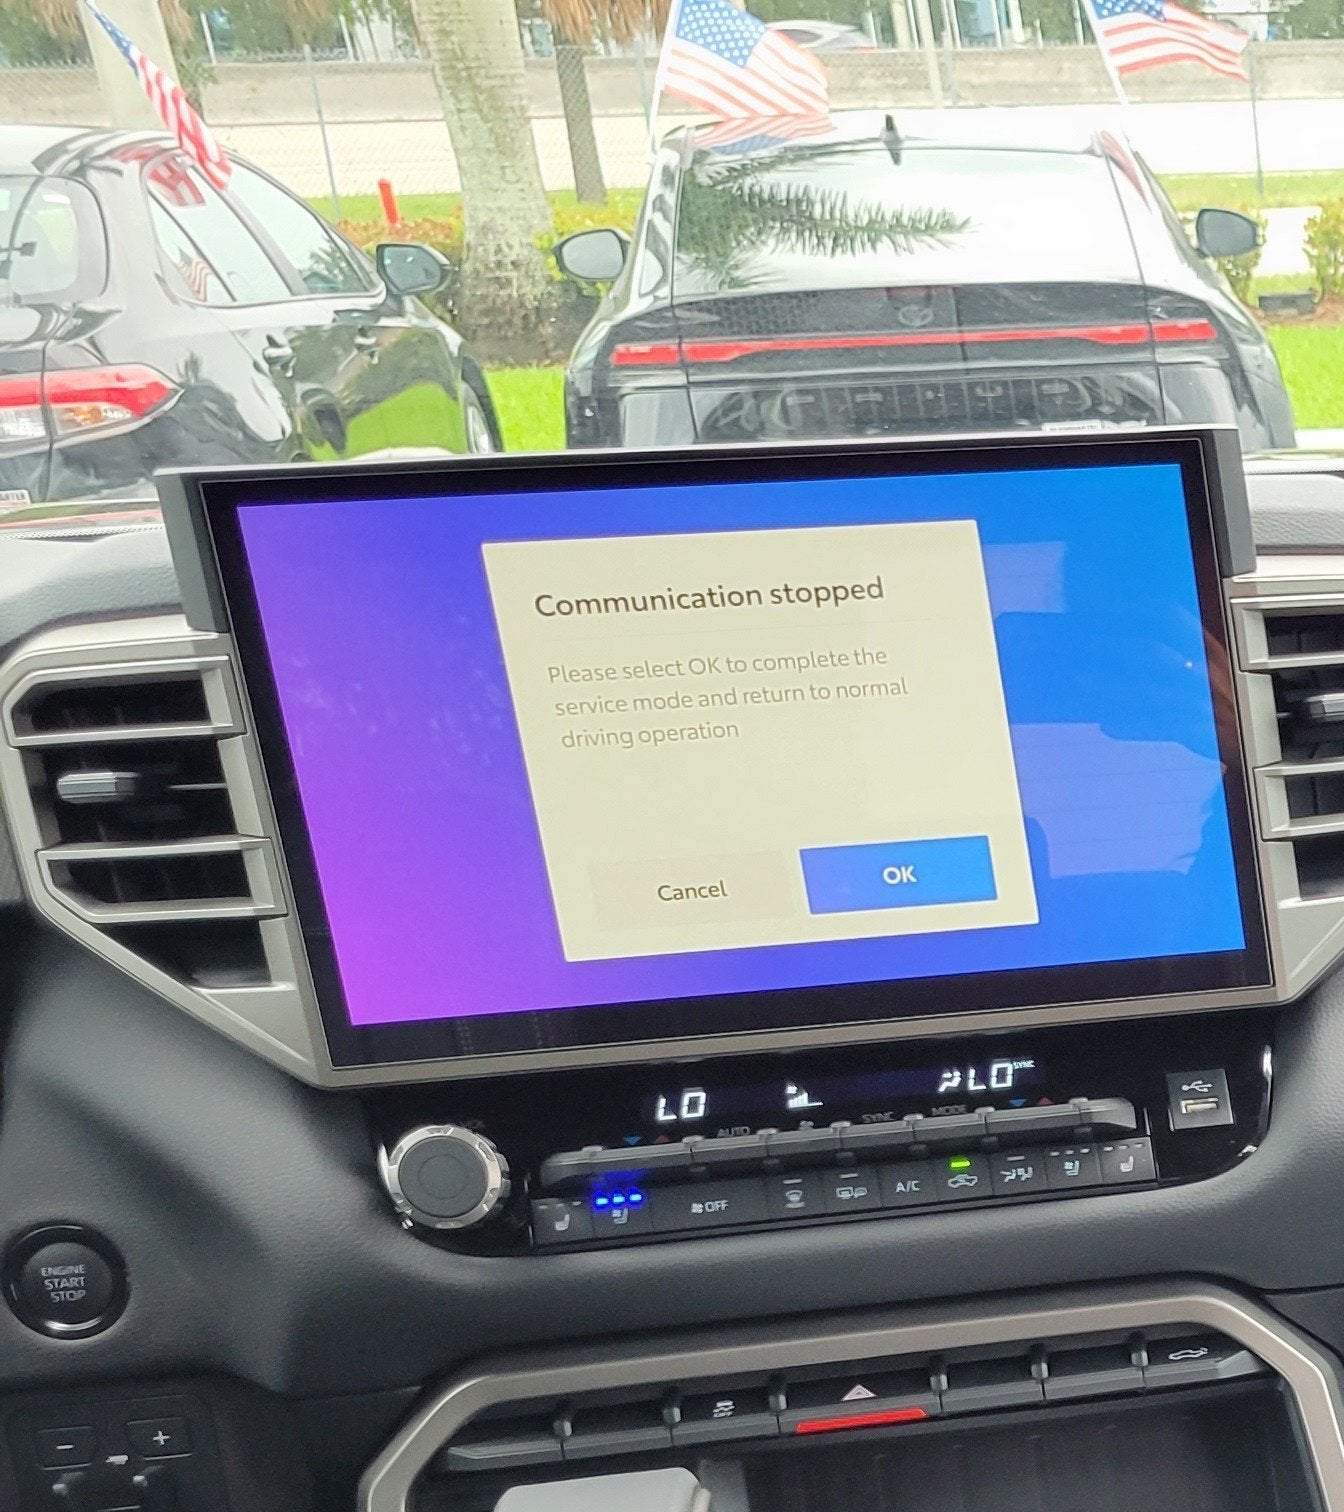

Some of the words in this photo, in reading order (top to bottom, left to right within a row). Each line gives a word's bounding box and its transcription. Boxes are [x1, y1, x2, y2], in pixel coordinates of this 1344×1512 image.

[534, 583, 763, 618] Communication
[769, 575, 885, 611] stopped
[547, 662, 618, 686] Please
[622, 658, 685, 681] select
[688, 656, 722, 678] OK
[725, 654, 748, 674] to
[752, 647, 850, 678] complete
[853, 646, 888, 667] the
[555, 694, 628, 717] service
[632, 689, 693, 714] mode
[697, 686, 738, 708] and
[742, 683, 805, 706] return
[808, 682, 832, 701] to
[835, 676, 909, 699] normal
[561, 726, 635, 751] driving
[638, 719, 740, 749] operation
[882, 865, 918, 887] OK
[657, 880, 729, 903] Cancel
[717, 1126, 750, 1138] AUTO
[896, 1180, 921, 1193] A/C
[704, 1199, 730, 1213] OFF
[41, 1263, 85, 1277] ENGINE
[44, 1276, 86, 1290] START
[50, 1289, 86, 1303] STOP
